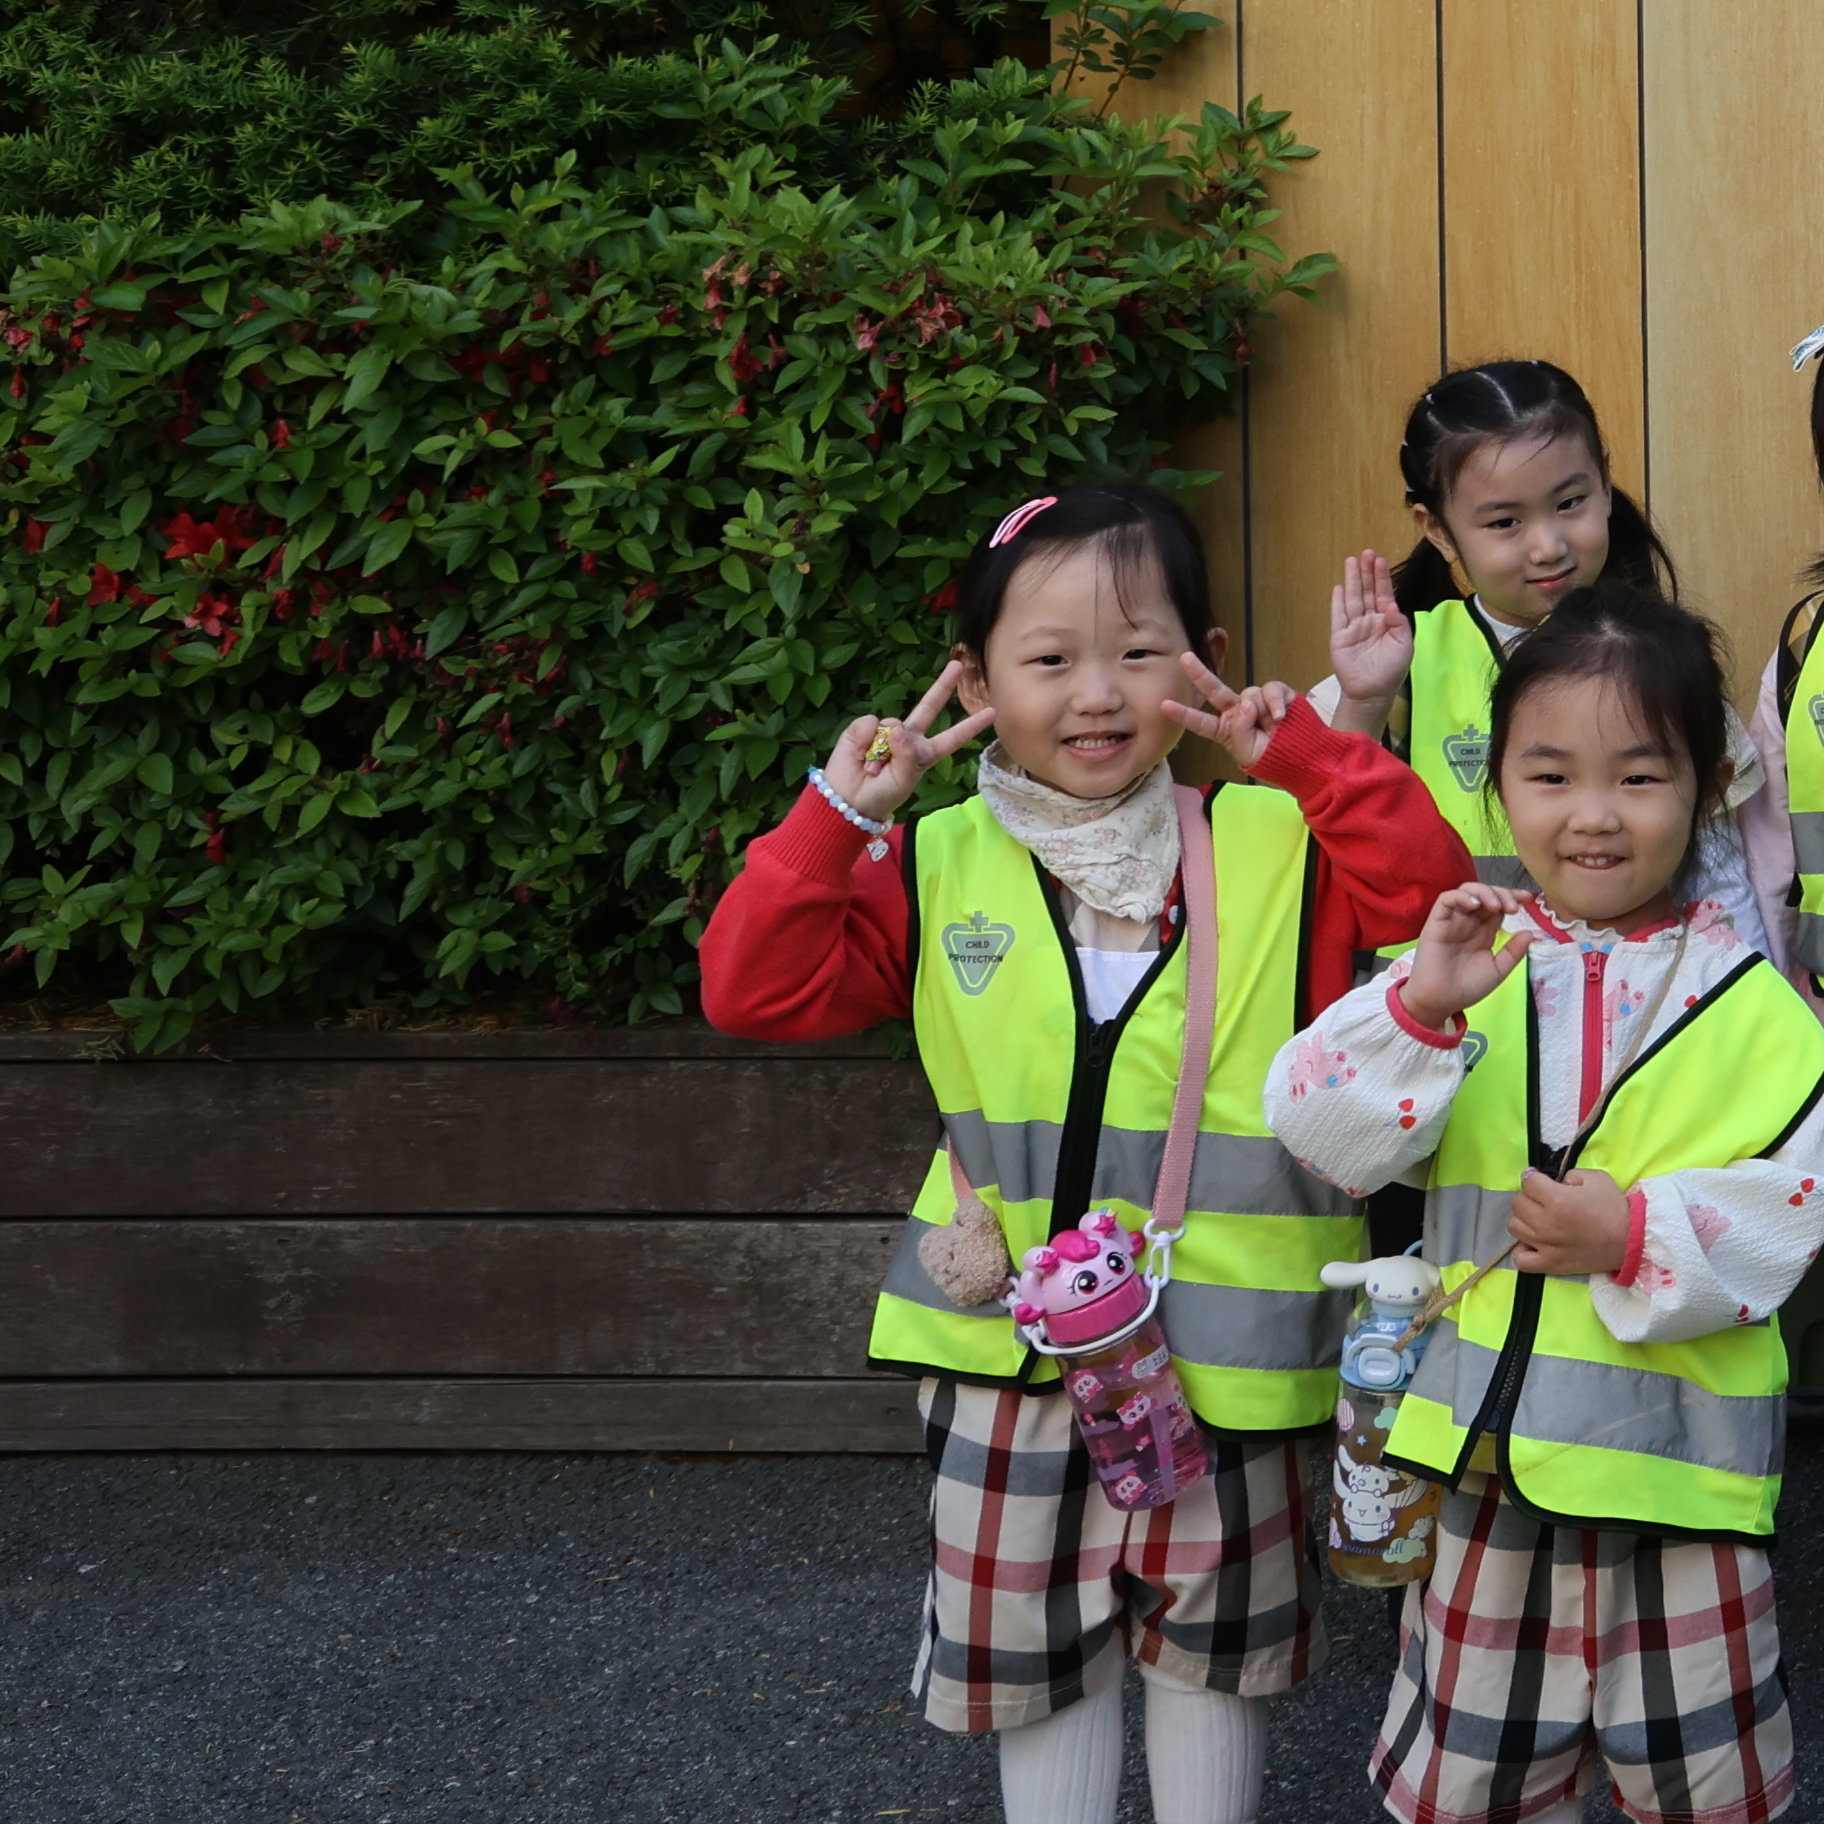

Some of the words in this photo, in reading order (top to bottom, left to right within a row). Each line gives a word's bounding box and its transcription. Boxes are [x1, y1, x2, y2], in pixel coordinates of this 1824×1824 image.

[1448, 759, 1489, 768] PROTECTIO
[965, 940, 990, 949] CHILD
[948, 953, 1004, 964] PROTECTION
